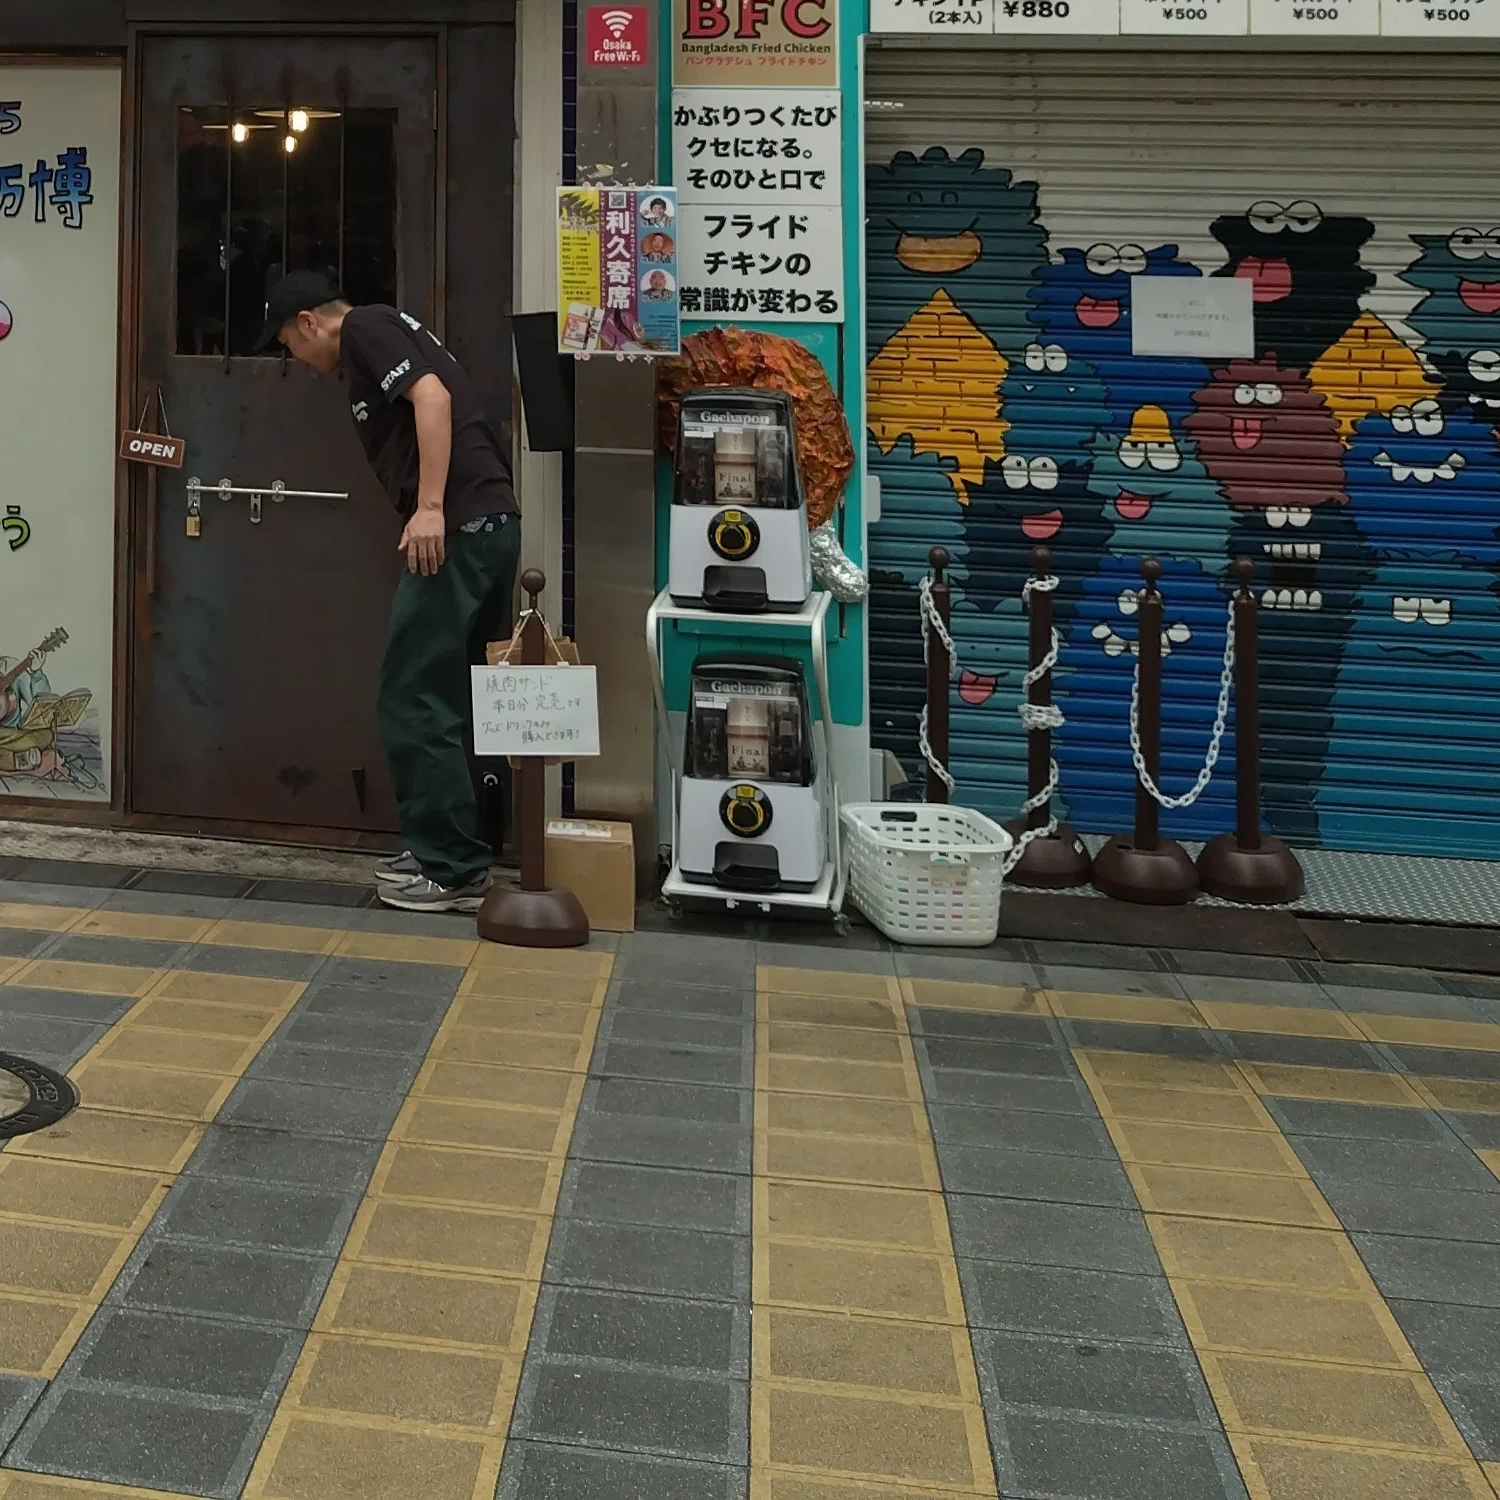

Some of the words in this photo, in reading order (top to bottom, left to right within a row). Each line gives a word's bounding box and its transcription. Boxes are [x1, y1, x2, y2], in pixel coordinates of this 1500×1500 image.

[1002, 0, 1071, 20] ¥880
[1162, 8, 1208, 22] ¥500
[1293, 8, 1340, 22] ¥500
[1424, 8, 1471, 22] ¥500
[603, 39, 632, 50] Osaka
[681, 43, 748, 54] Bangladesh
[751, 43, 781, 53] Fried
[784, 43, 831, 53] Chicken
[594, 50, 616, 61] Free
[673, 105, 837, 129] かぶりつくたび
[687, 137, 814, 159] クセになる。
[687, 168, 827, 191] そのひと口で
[703, 214, 809, 239] フライド
[605, 210, 632, 310] 利久寄席
[703, 251, 811, 277] チキンの
[679, 287, 839, 315] 常識が変わる
[381, 358, 411, 391] STAFF
[700, 411, 771, 425] Gachapon
[129, 439, 176, 459] OPEN
